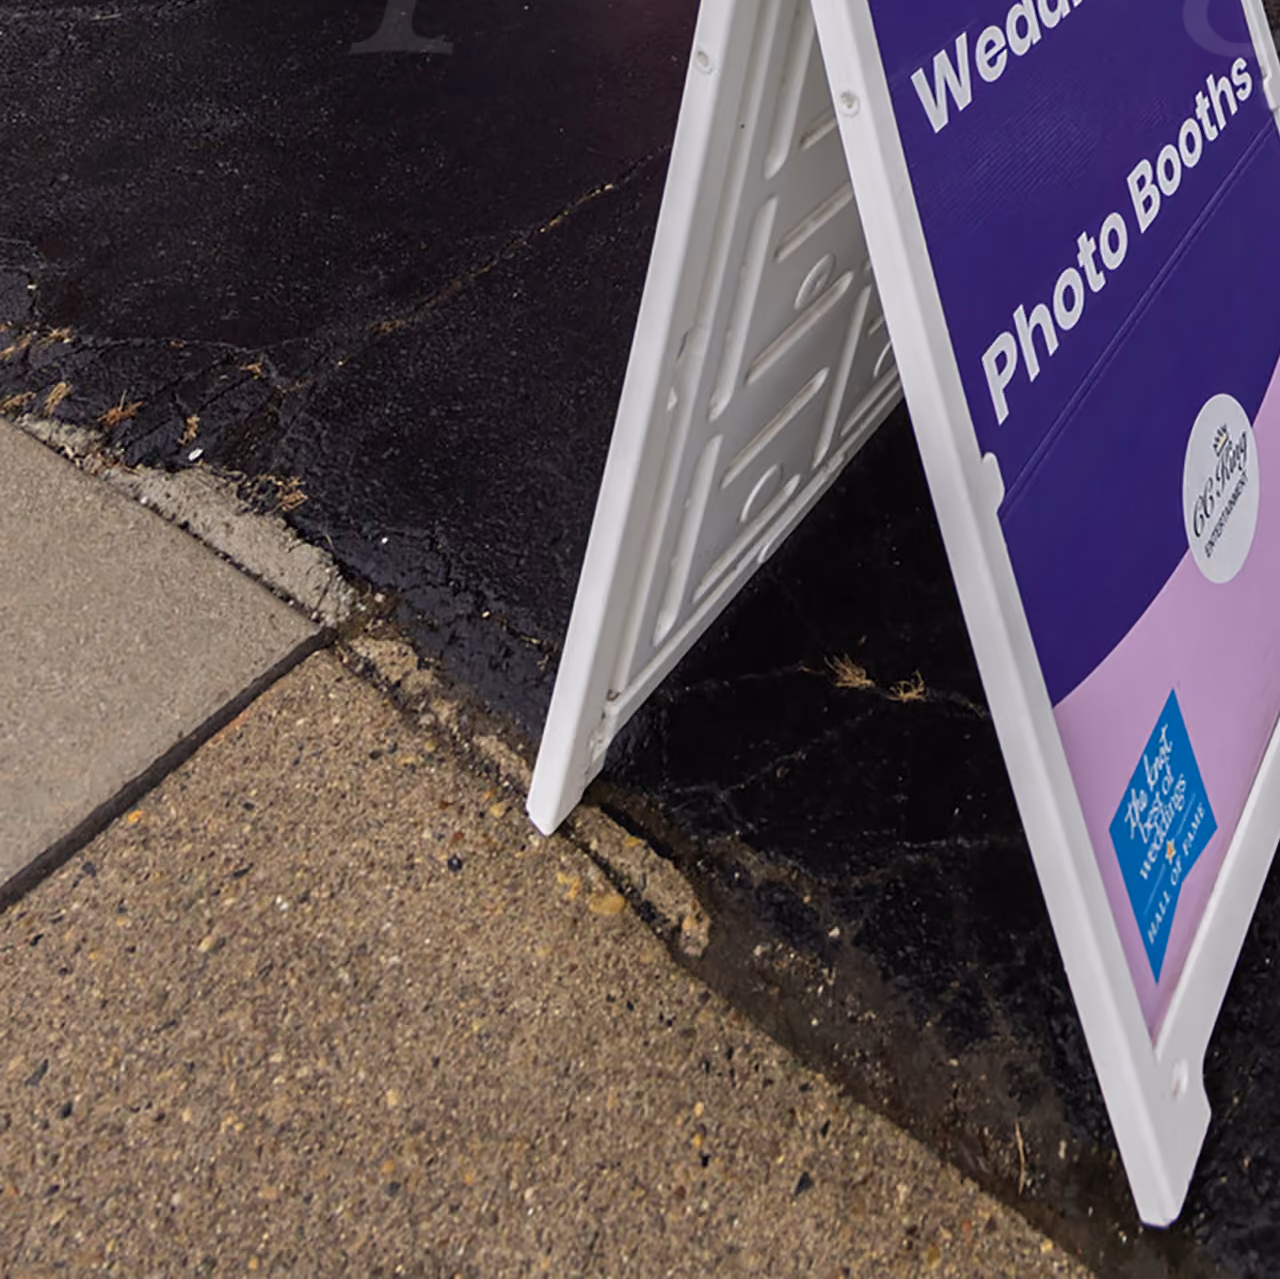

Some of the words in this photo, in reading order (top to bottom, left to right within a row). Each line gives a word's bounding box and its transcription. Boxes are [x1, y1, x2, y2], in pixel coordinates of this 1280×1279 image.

[981, 211, 1128, 426] Photo
[1126, 55, 1254, 233] Booths
[1139, 773, 1187, 881] weddings
[1147, 890, 1171, 945] HALL
[1169, 856, 1183, 887] OF
[1182, 802, 1207, 857] FAME
